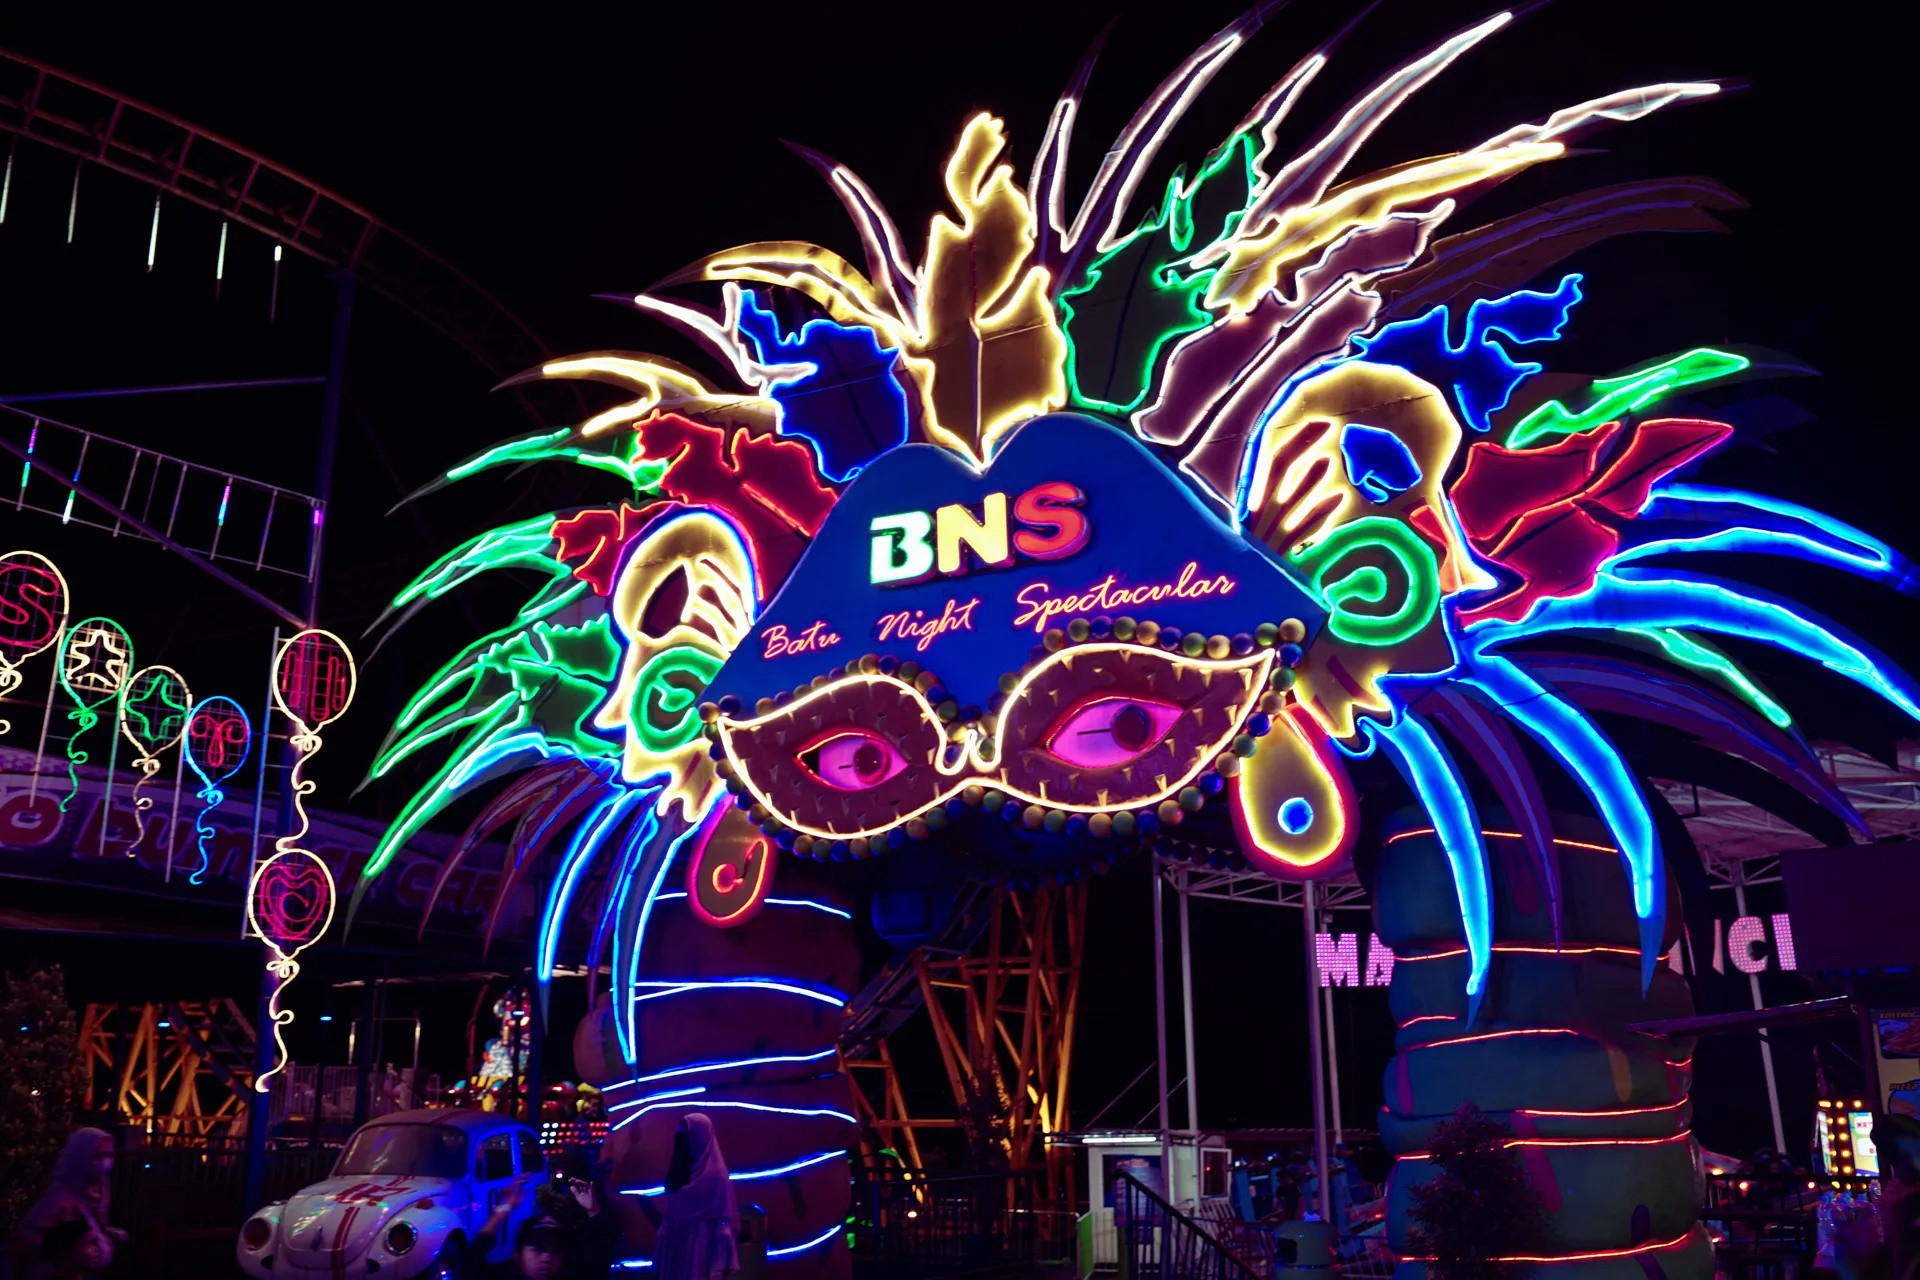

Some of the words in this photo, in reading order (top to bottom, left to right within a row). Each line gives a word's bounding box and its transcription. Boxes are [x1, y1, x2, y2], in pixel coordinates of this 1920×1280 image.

[869, 481, 1091, 586] BNS
[761, 620, 841, 660] Batu
[877, 597, 981, 652] Night
[1013, 561, 1236, 633] Spectacular
